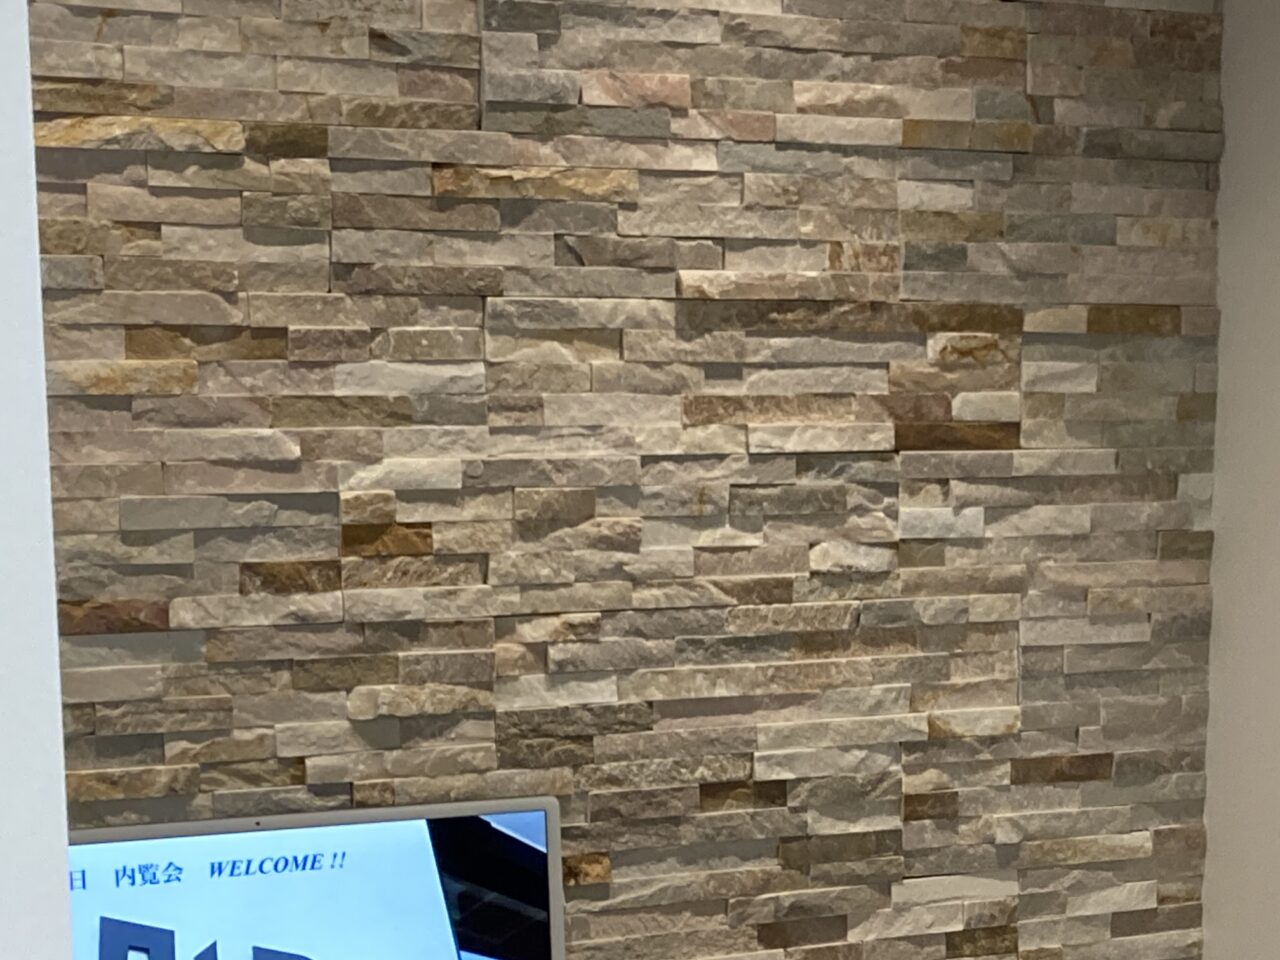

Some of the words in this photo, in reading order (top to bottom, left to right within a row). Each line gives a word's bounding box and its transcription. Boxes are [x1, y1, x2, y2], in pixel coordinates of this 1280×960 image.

[114, 861, 184, 888] 内覧会
[209, 853, 324, 879] WELCOME
